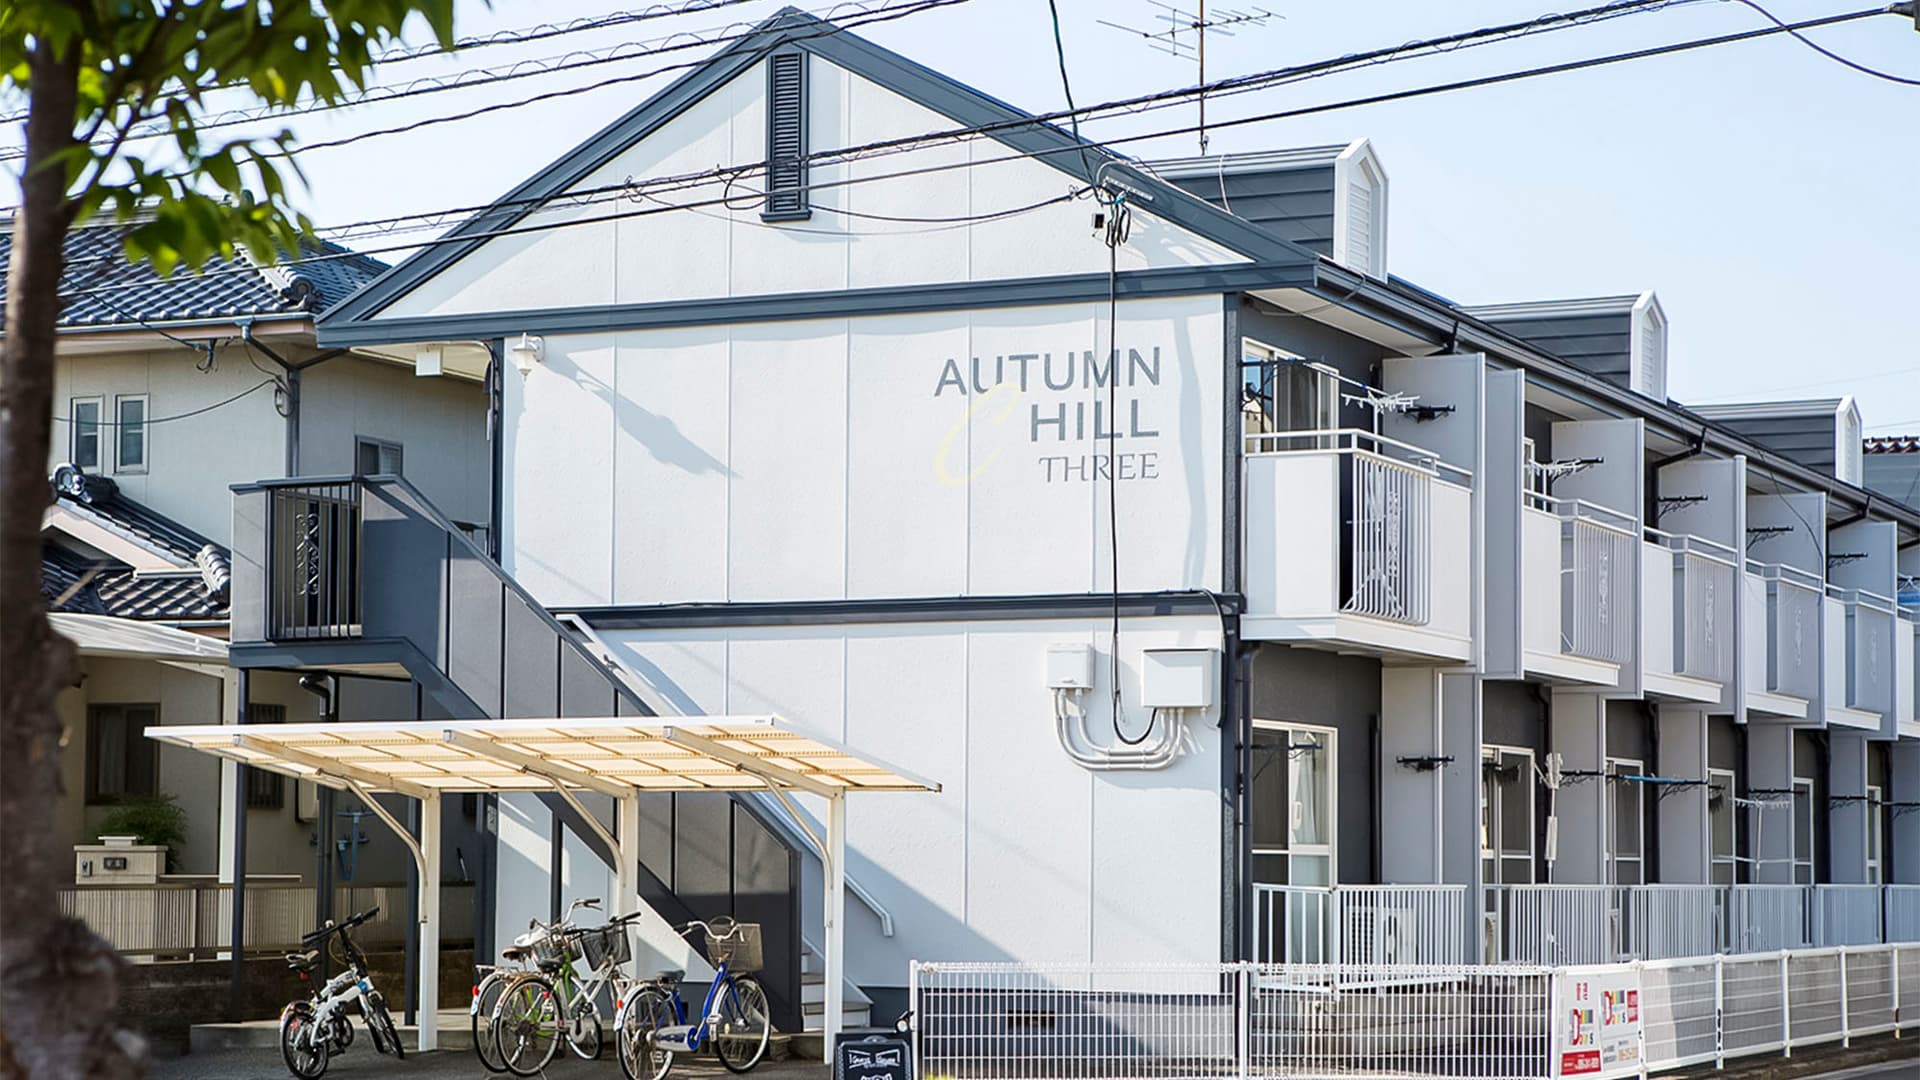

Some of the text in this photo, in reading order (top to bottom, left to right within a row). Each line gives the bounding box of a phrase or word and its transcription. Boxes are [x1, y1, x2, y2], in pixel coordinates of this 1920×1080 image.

[934, 346, 1161, 397] AUTUMN
[1030, 398, 1160, 442] HILL
[1038, 452, 1160, 483] THREE
